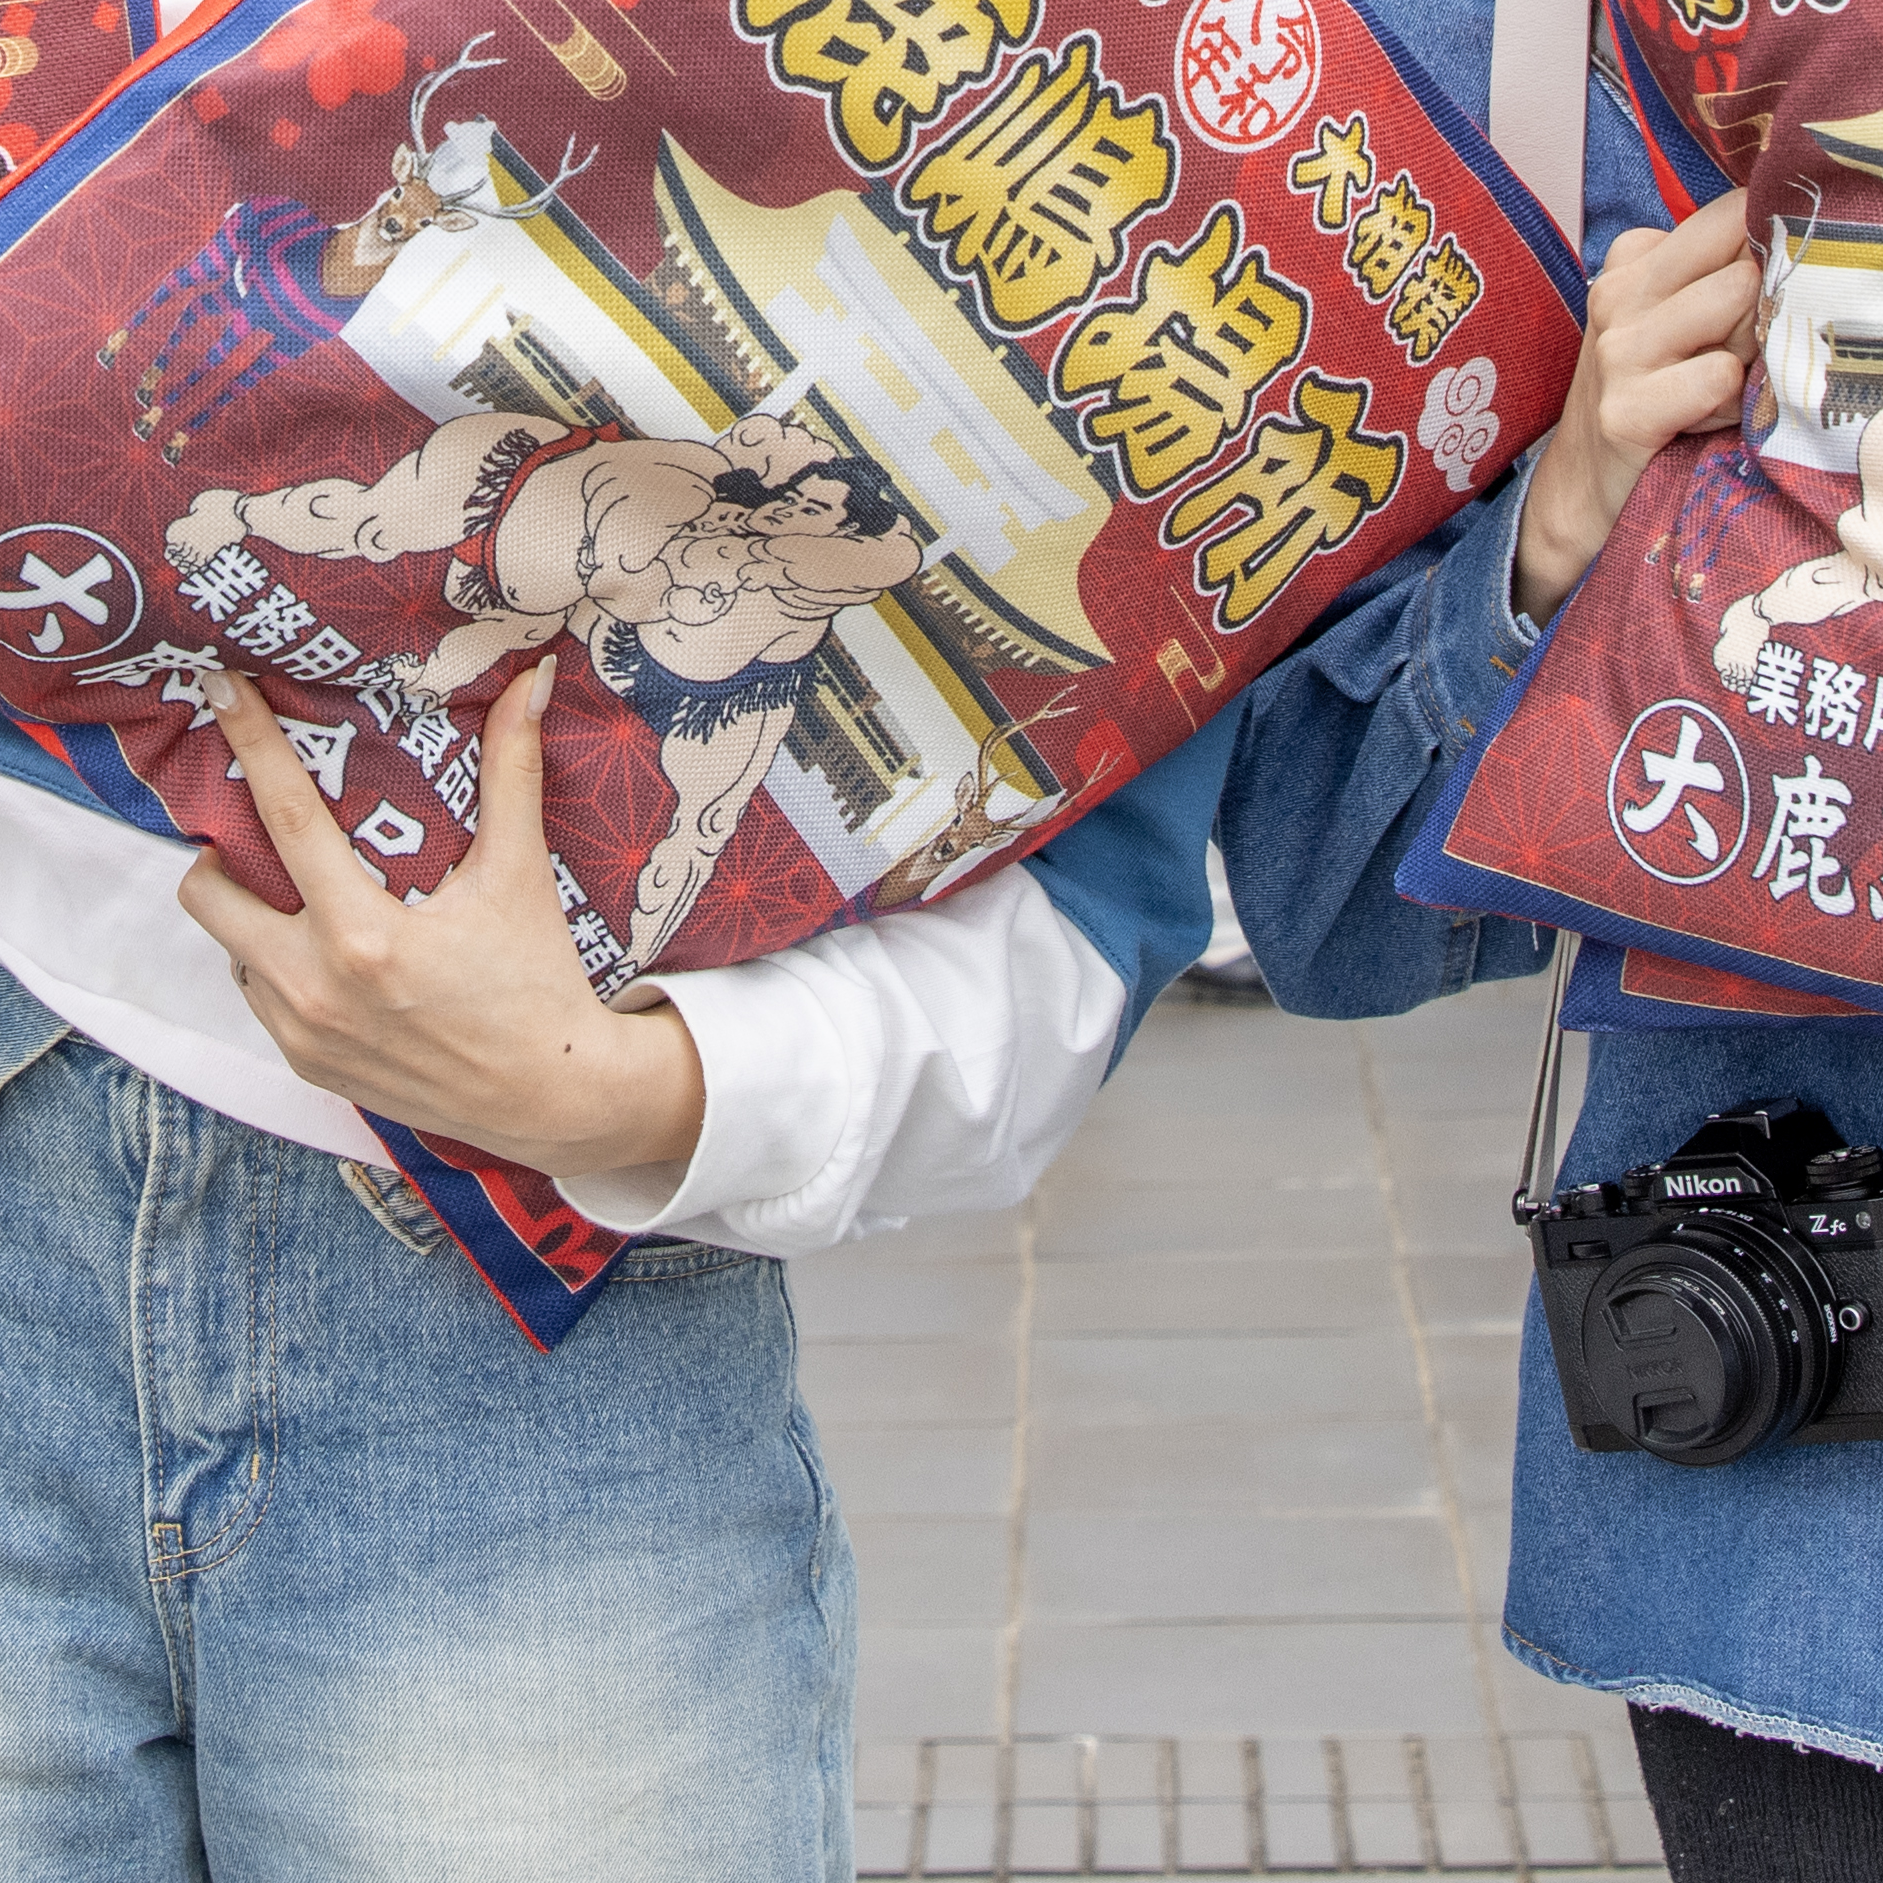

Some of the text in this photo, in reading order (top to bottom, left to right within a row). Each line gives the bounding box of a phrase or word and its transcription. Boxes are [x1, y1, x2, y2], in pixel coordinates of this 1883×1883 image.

[1288, 112, 1483, 362] 大相撲
[1664, 1174, 1742, 1198] Nikon
